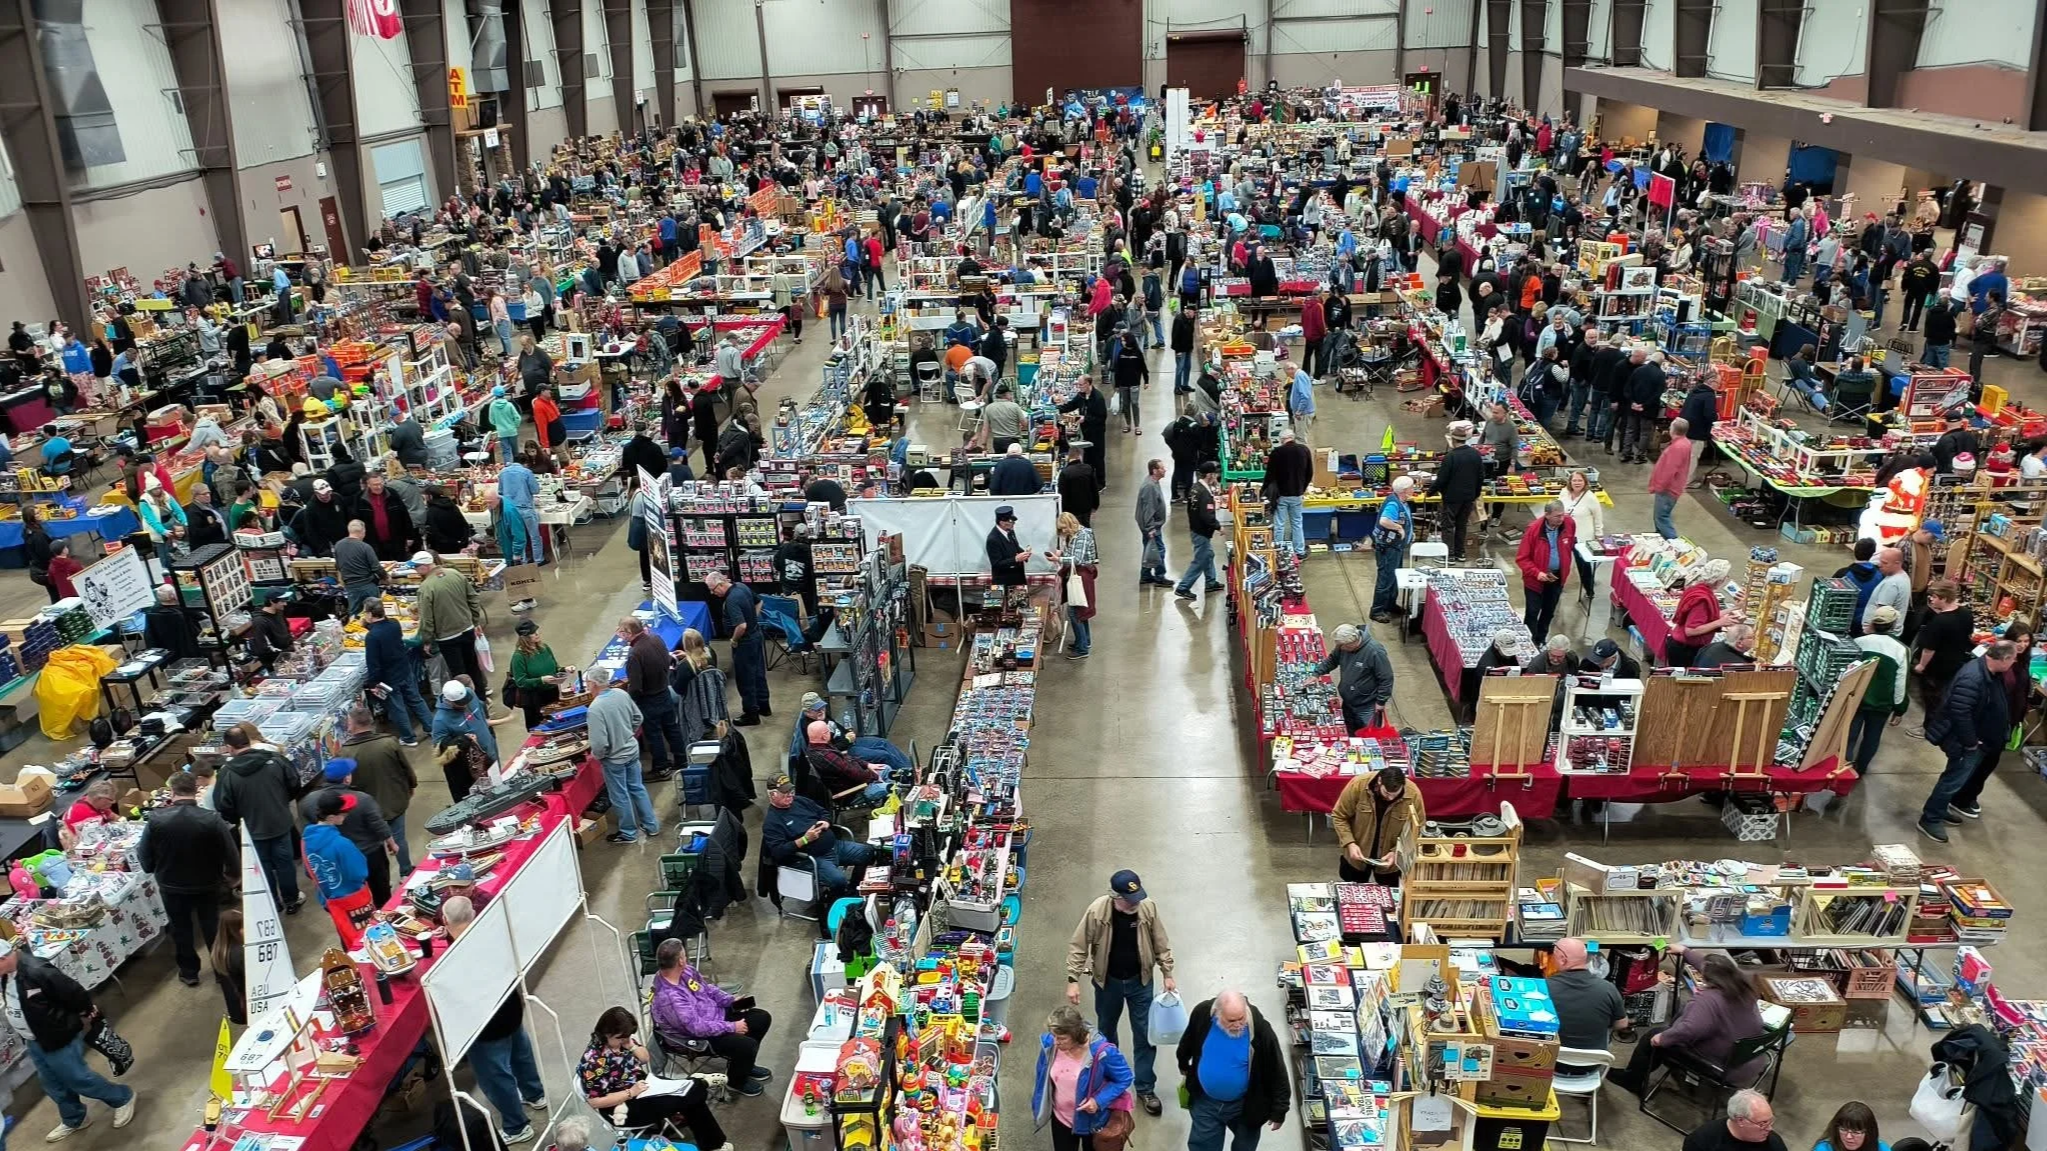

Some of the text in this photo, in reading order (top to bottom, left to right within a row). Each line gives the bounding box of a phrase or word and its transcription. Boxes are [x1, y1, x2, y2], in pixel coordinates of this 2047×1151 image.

[450, 69, 465, 105] ATM
[258, 943, 279, 963] 687
[250, 1000, 270, 1015] USA
[240, 1053, 263, 1061] 687
[1365, 1095, 1374, 1116] LIONEL
